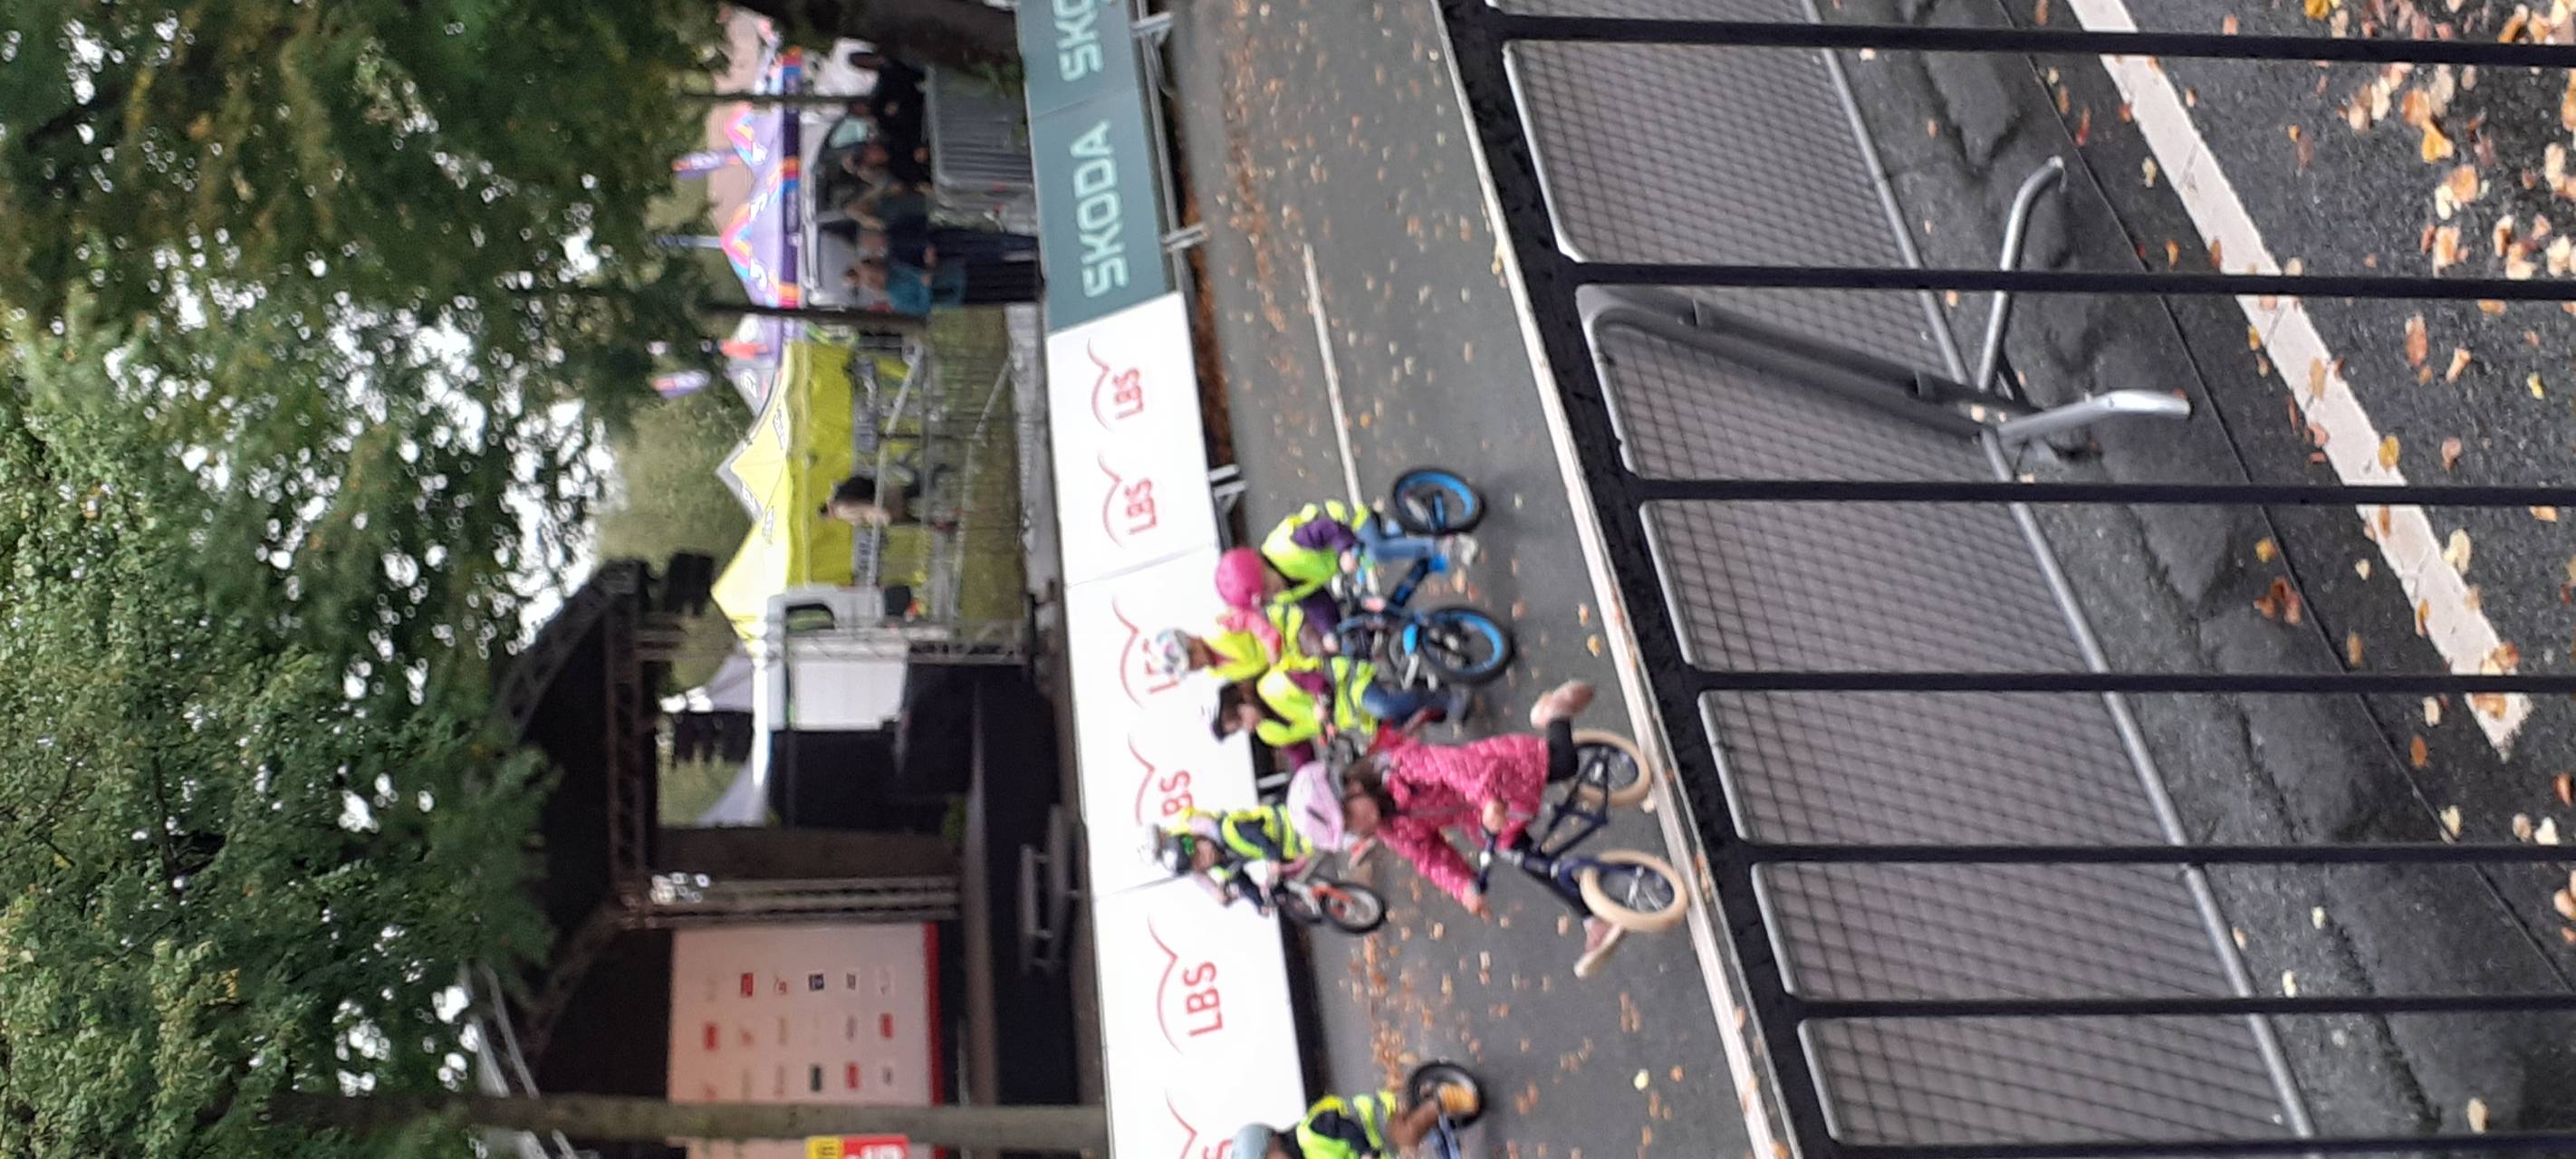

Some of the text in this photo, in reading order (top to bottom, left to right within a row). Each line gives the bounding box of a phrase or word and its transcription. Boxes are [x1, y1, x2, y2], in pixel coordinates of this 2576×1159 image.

[1113, 368, 1144, 419] LBS
[1125, 478, 1157, 534] LBS
[1158, 770, 1193, 817] BS
[1182, 961, 1223, 1037] LBS
